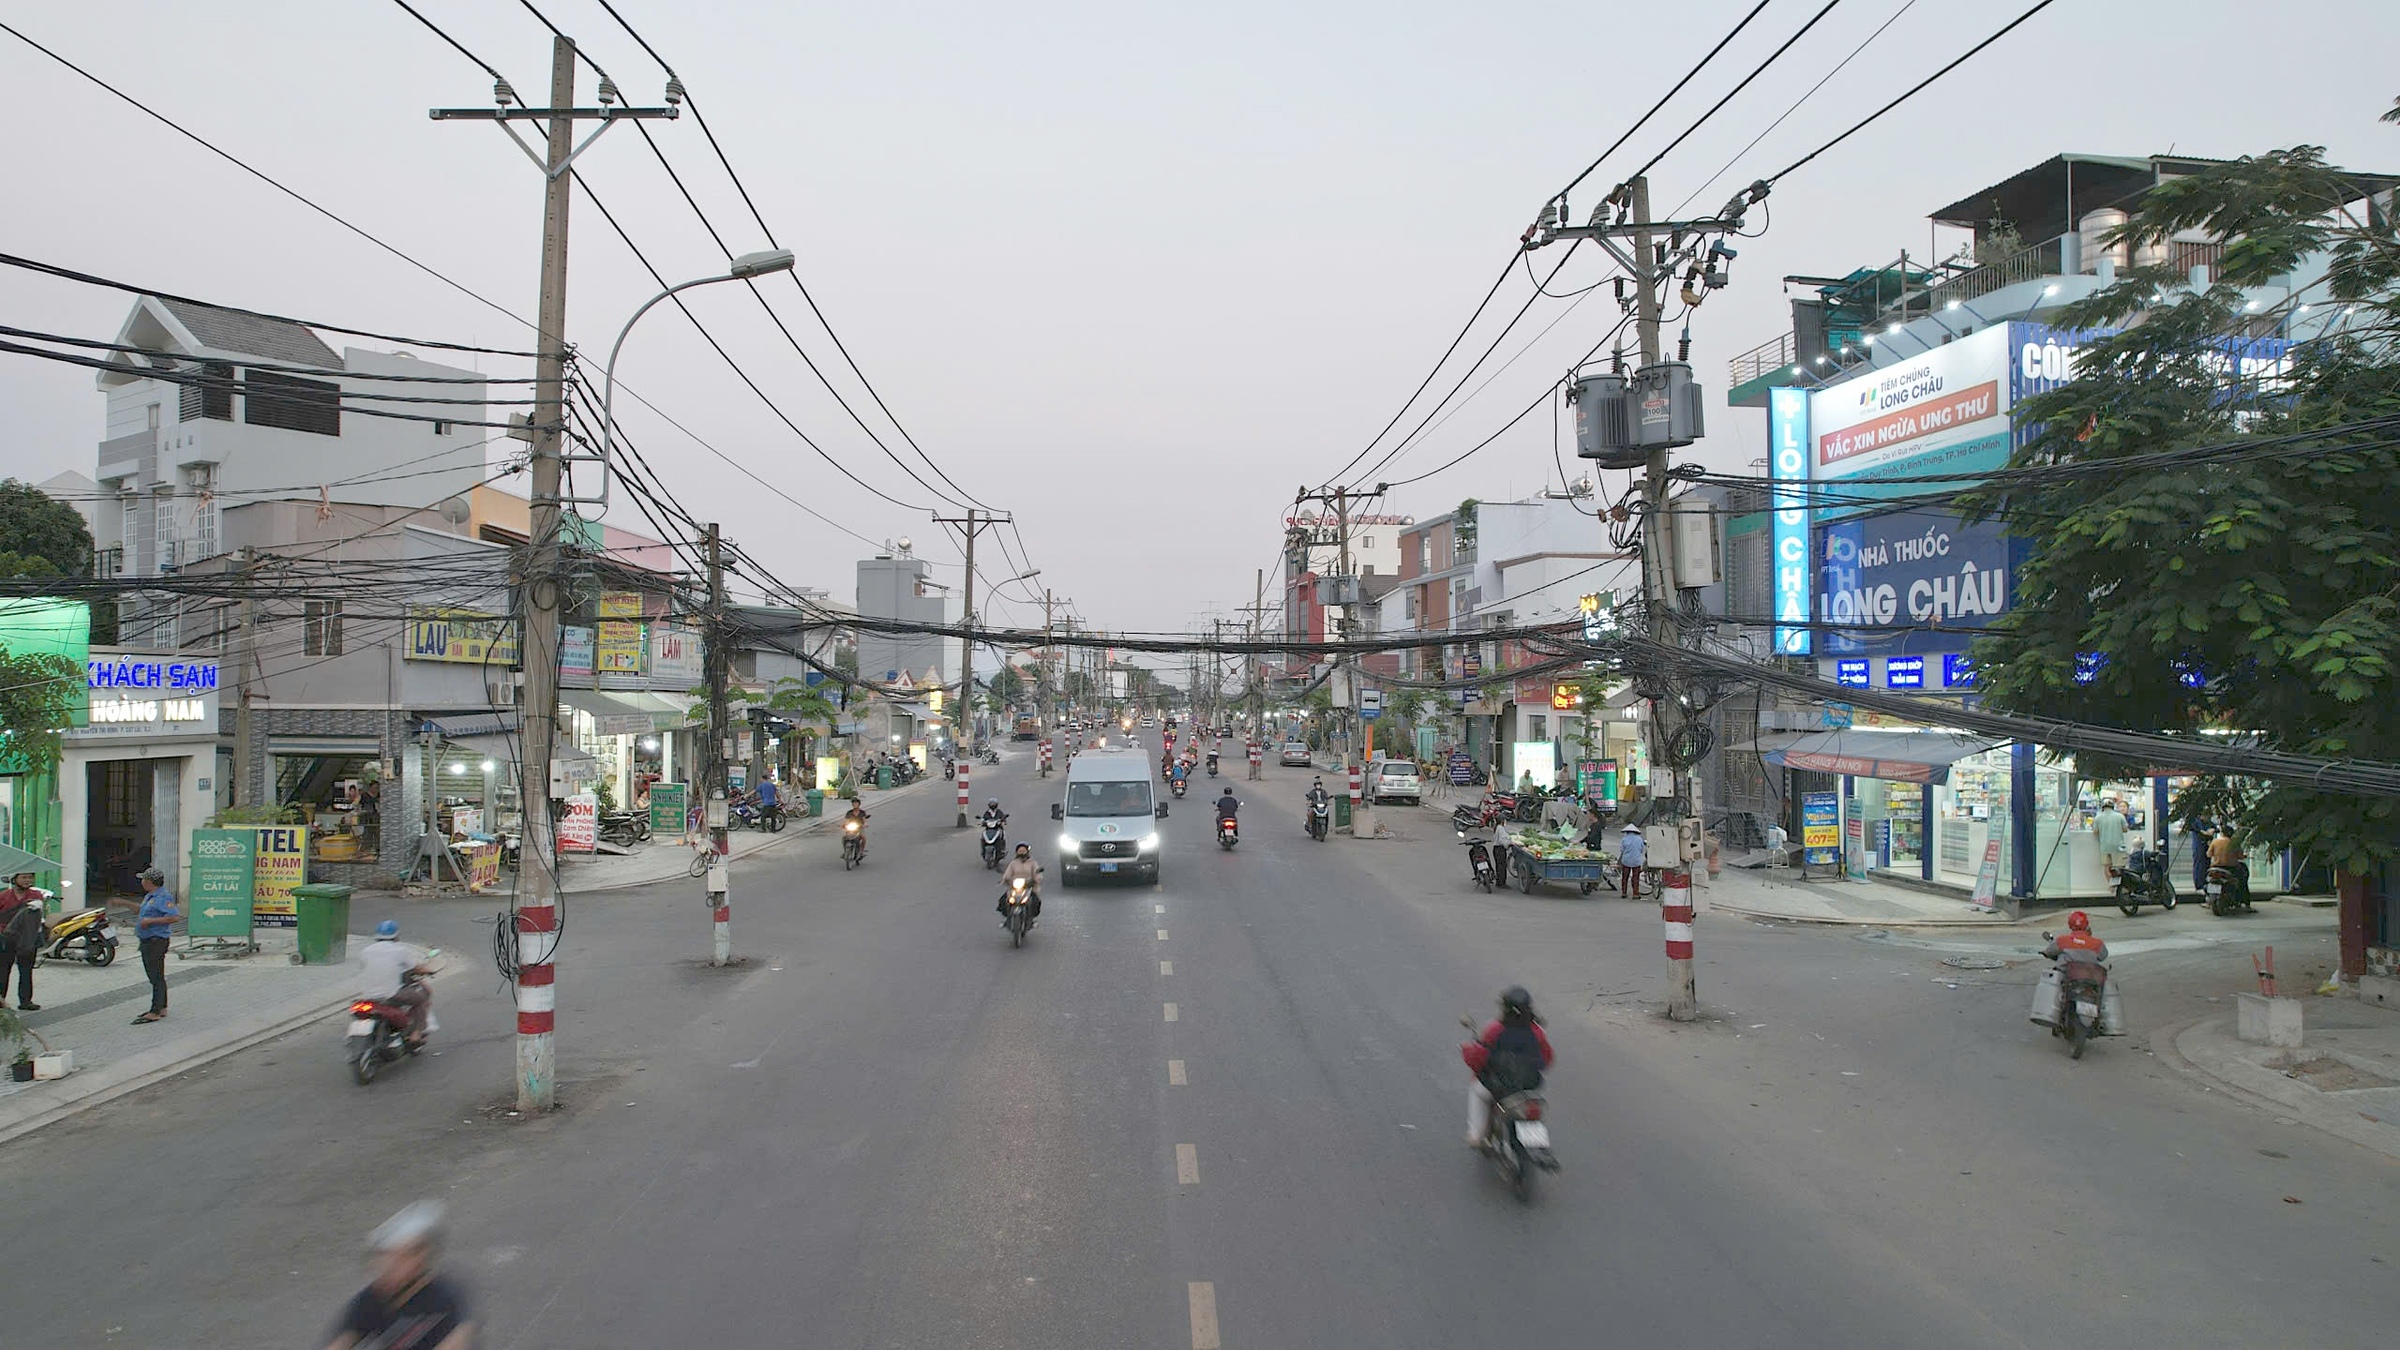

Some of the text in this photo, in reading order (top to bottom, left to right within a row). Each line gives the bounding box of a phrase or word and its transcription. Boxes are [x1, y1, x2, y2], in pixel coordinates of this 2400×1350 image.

[1881, 376, 1943, 410] LONG CHÂU
[1826, 391, 1990, 459] VẮC XIN NGỪA UNG THƯ
[1981, 439, 2001, 452] Minh
[1858, 525, 1950, 570] NHÀ THUỐC
[1821, 560, 2003, 625] LONG CHÂU
[169, 662, 217, 696] SẠN
[91, 693, 206, 722] HOÀNG NAM
[1598, 761, 1616, 773] ANH
[1806, 834, 1827, 845] 407
[272, 856, 301, 869] NAM
